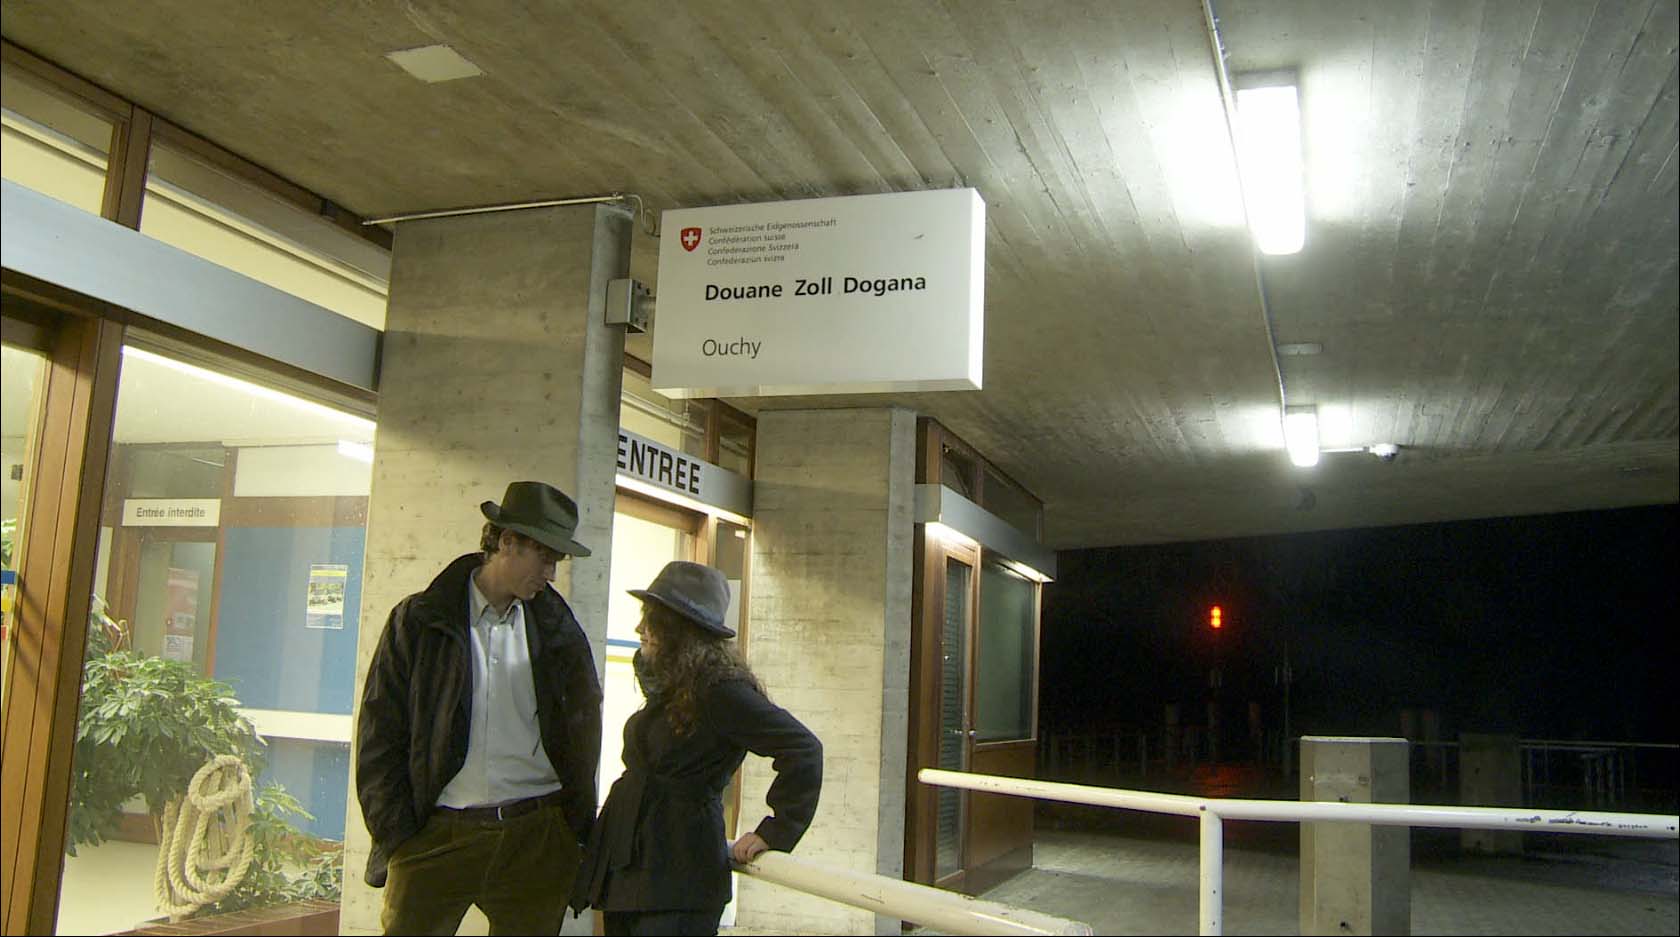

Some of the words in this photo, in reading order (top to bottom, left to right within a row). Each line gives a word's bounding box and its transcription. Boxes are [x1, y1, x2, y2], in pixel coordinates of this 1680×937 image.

[705, 283, 783, 301] Douane
[794, 277, 832, 296] Zoll
[843, 276, 926, 296] Dogana
[702, 337, 762, 359] Ouchy
[617, 435, 700, 494] ENTREE
[136, 507, 165, 517] Entrée
[168, 507, 205, 517] interdite
